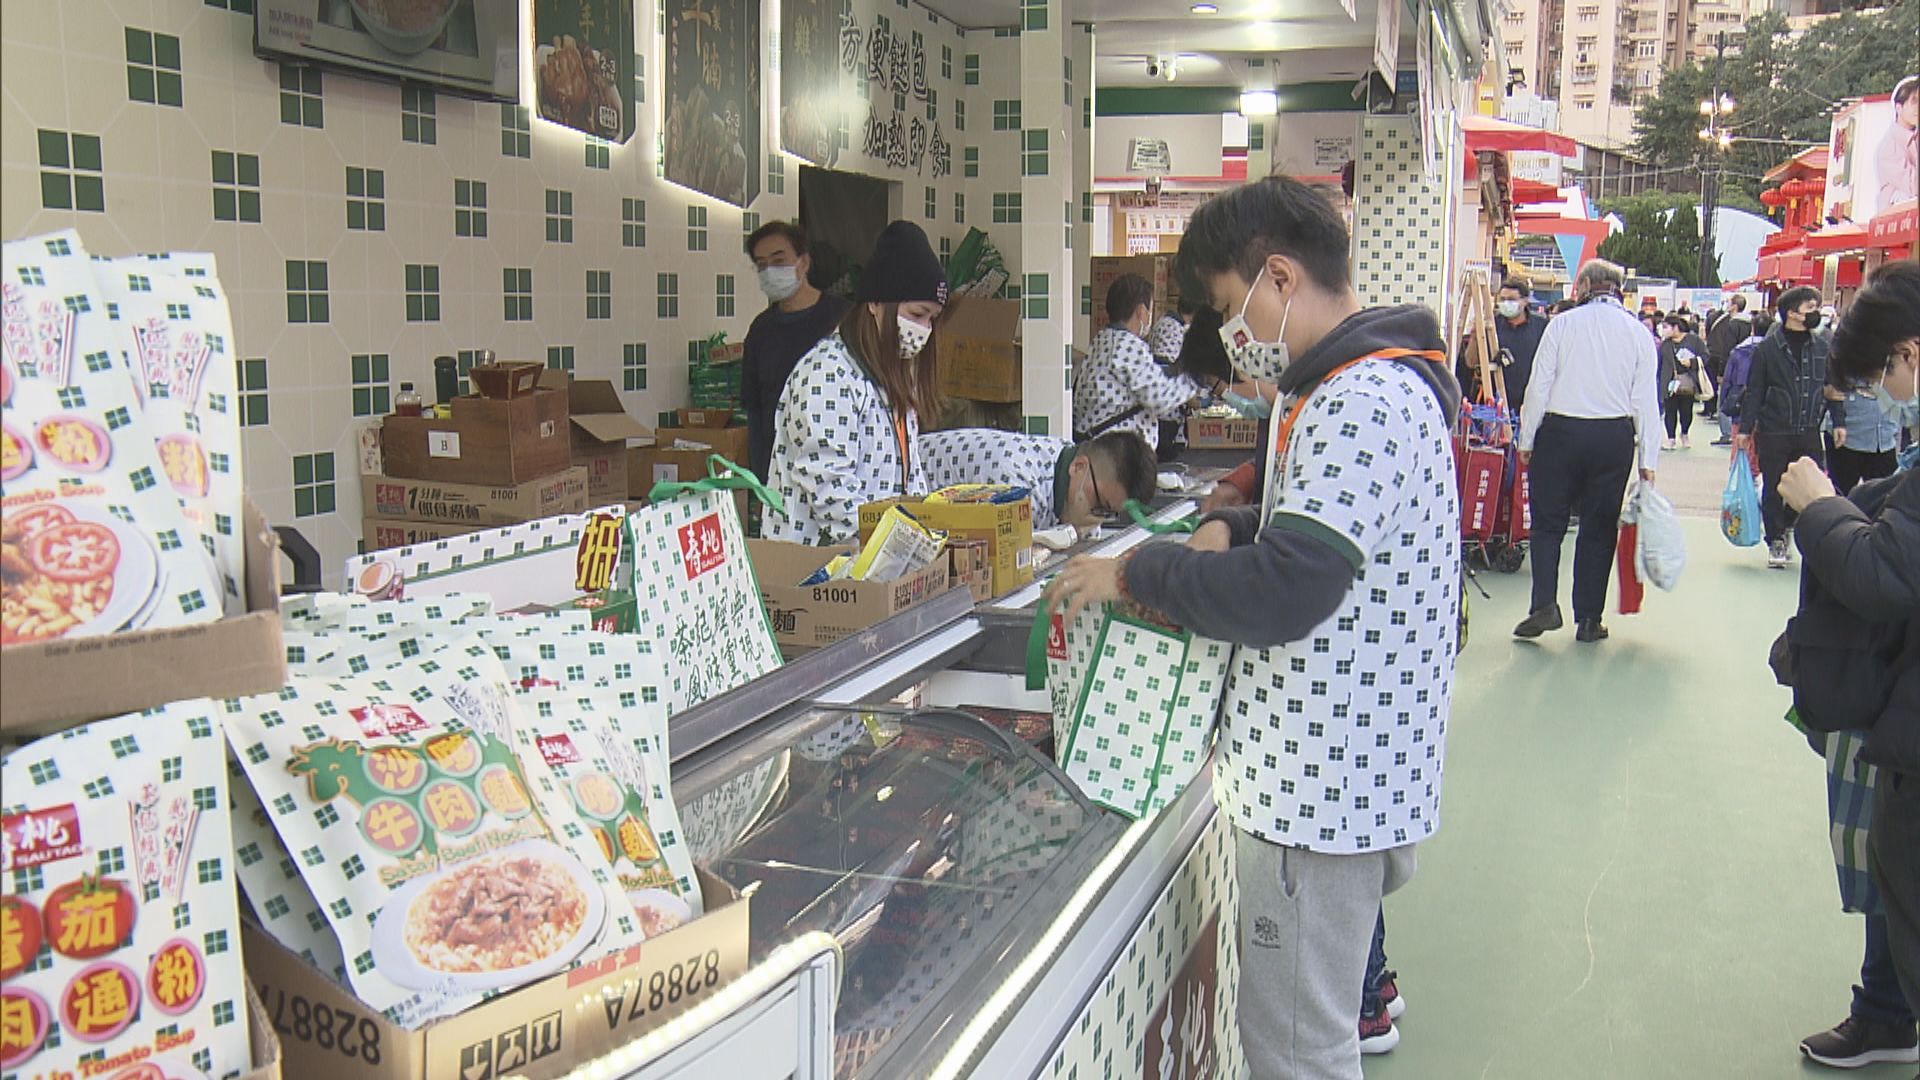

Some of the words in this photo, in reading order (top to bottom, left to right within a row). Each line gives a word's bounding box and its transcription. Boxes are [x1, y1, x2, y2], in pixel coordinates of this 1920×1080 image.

[841, 14, 928, 99] 方便餸包
[863, 105, 946, 177] 加熱即食
[576, 514, 624, 591] 抵
[813, 587, 858, 604] 81001
[262, 984, 380, 1065] 82887
[603, 948, 719, 1029] 82887A
[78, 1045, 151, 1077] Tomato
[155, 1028, 196, 1053] Soup
